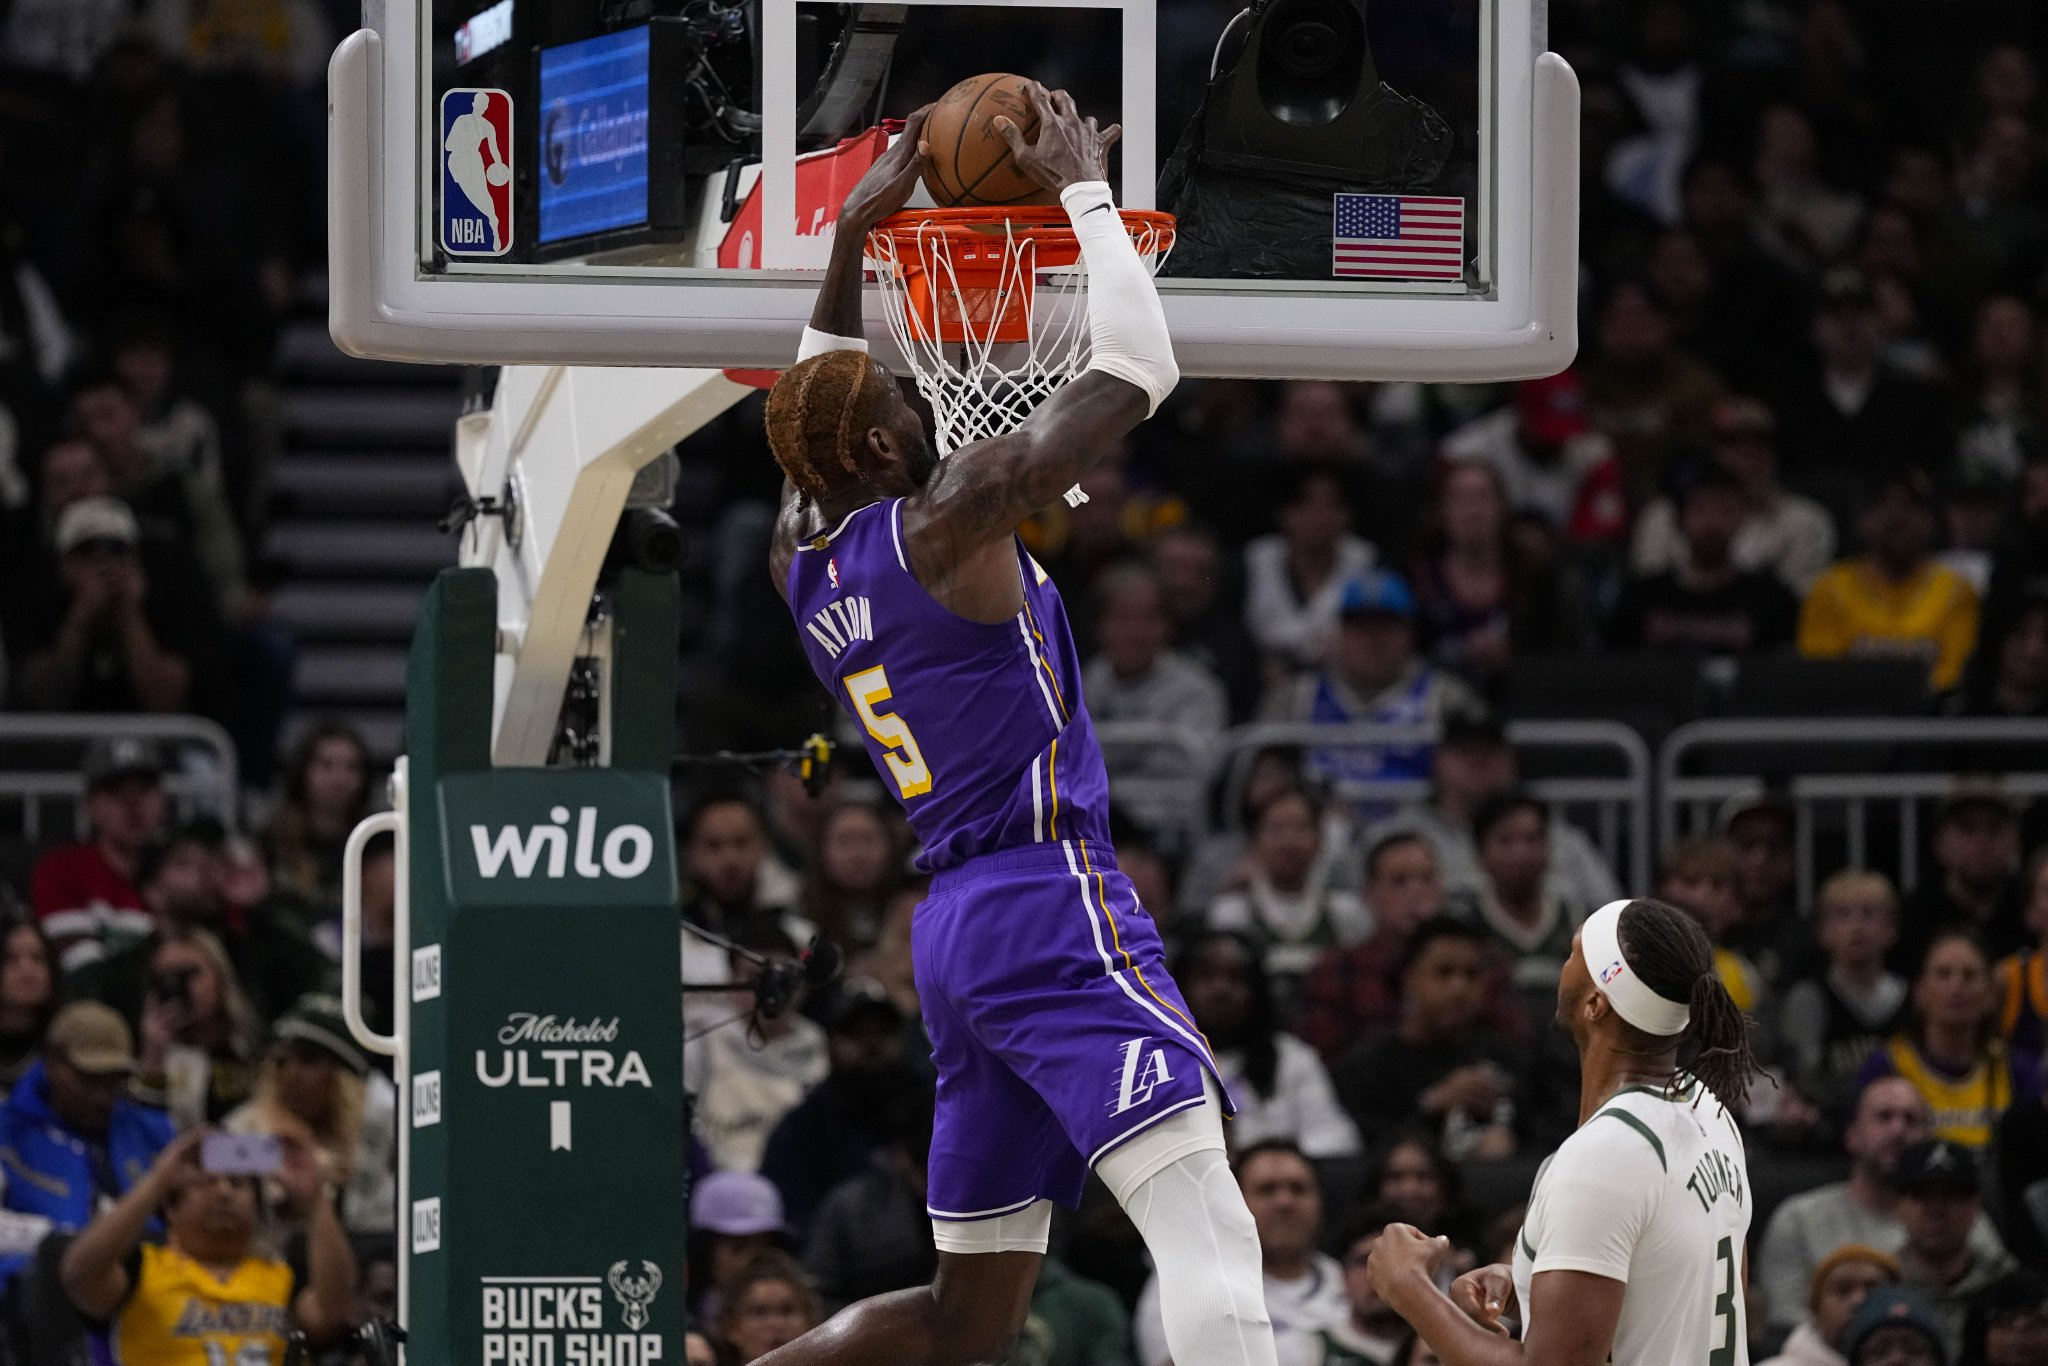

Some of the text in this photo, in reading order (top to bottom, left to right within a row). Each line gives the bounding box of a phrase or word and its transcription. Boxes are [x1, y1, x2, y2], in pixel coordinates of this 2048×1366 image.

[451, 218, 485, 243] NBA
[806, 596, 873, 659] AYTON
[843, 664, 932, 800] 5
[470, 805, 653, 879] wilo
[498, 1012, 620, 1045] Michelob
[475, 1049, 653, 1088] ULTRA
[1686, 1148, 1743, 1214] TURNER
[482, 1286, 602, 1329] BUCKS
[1709, 1235, 1736, 1366] 3
[482, 1333, 662, 1366] PRO SHOP
